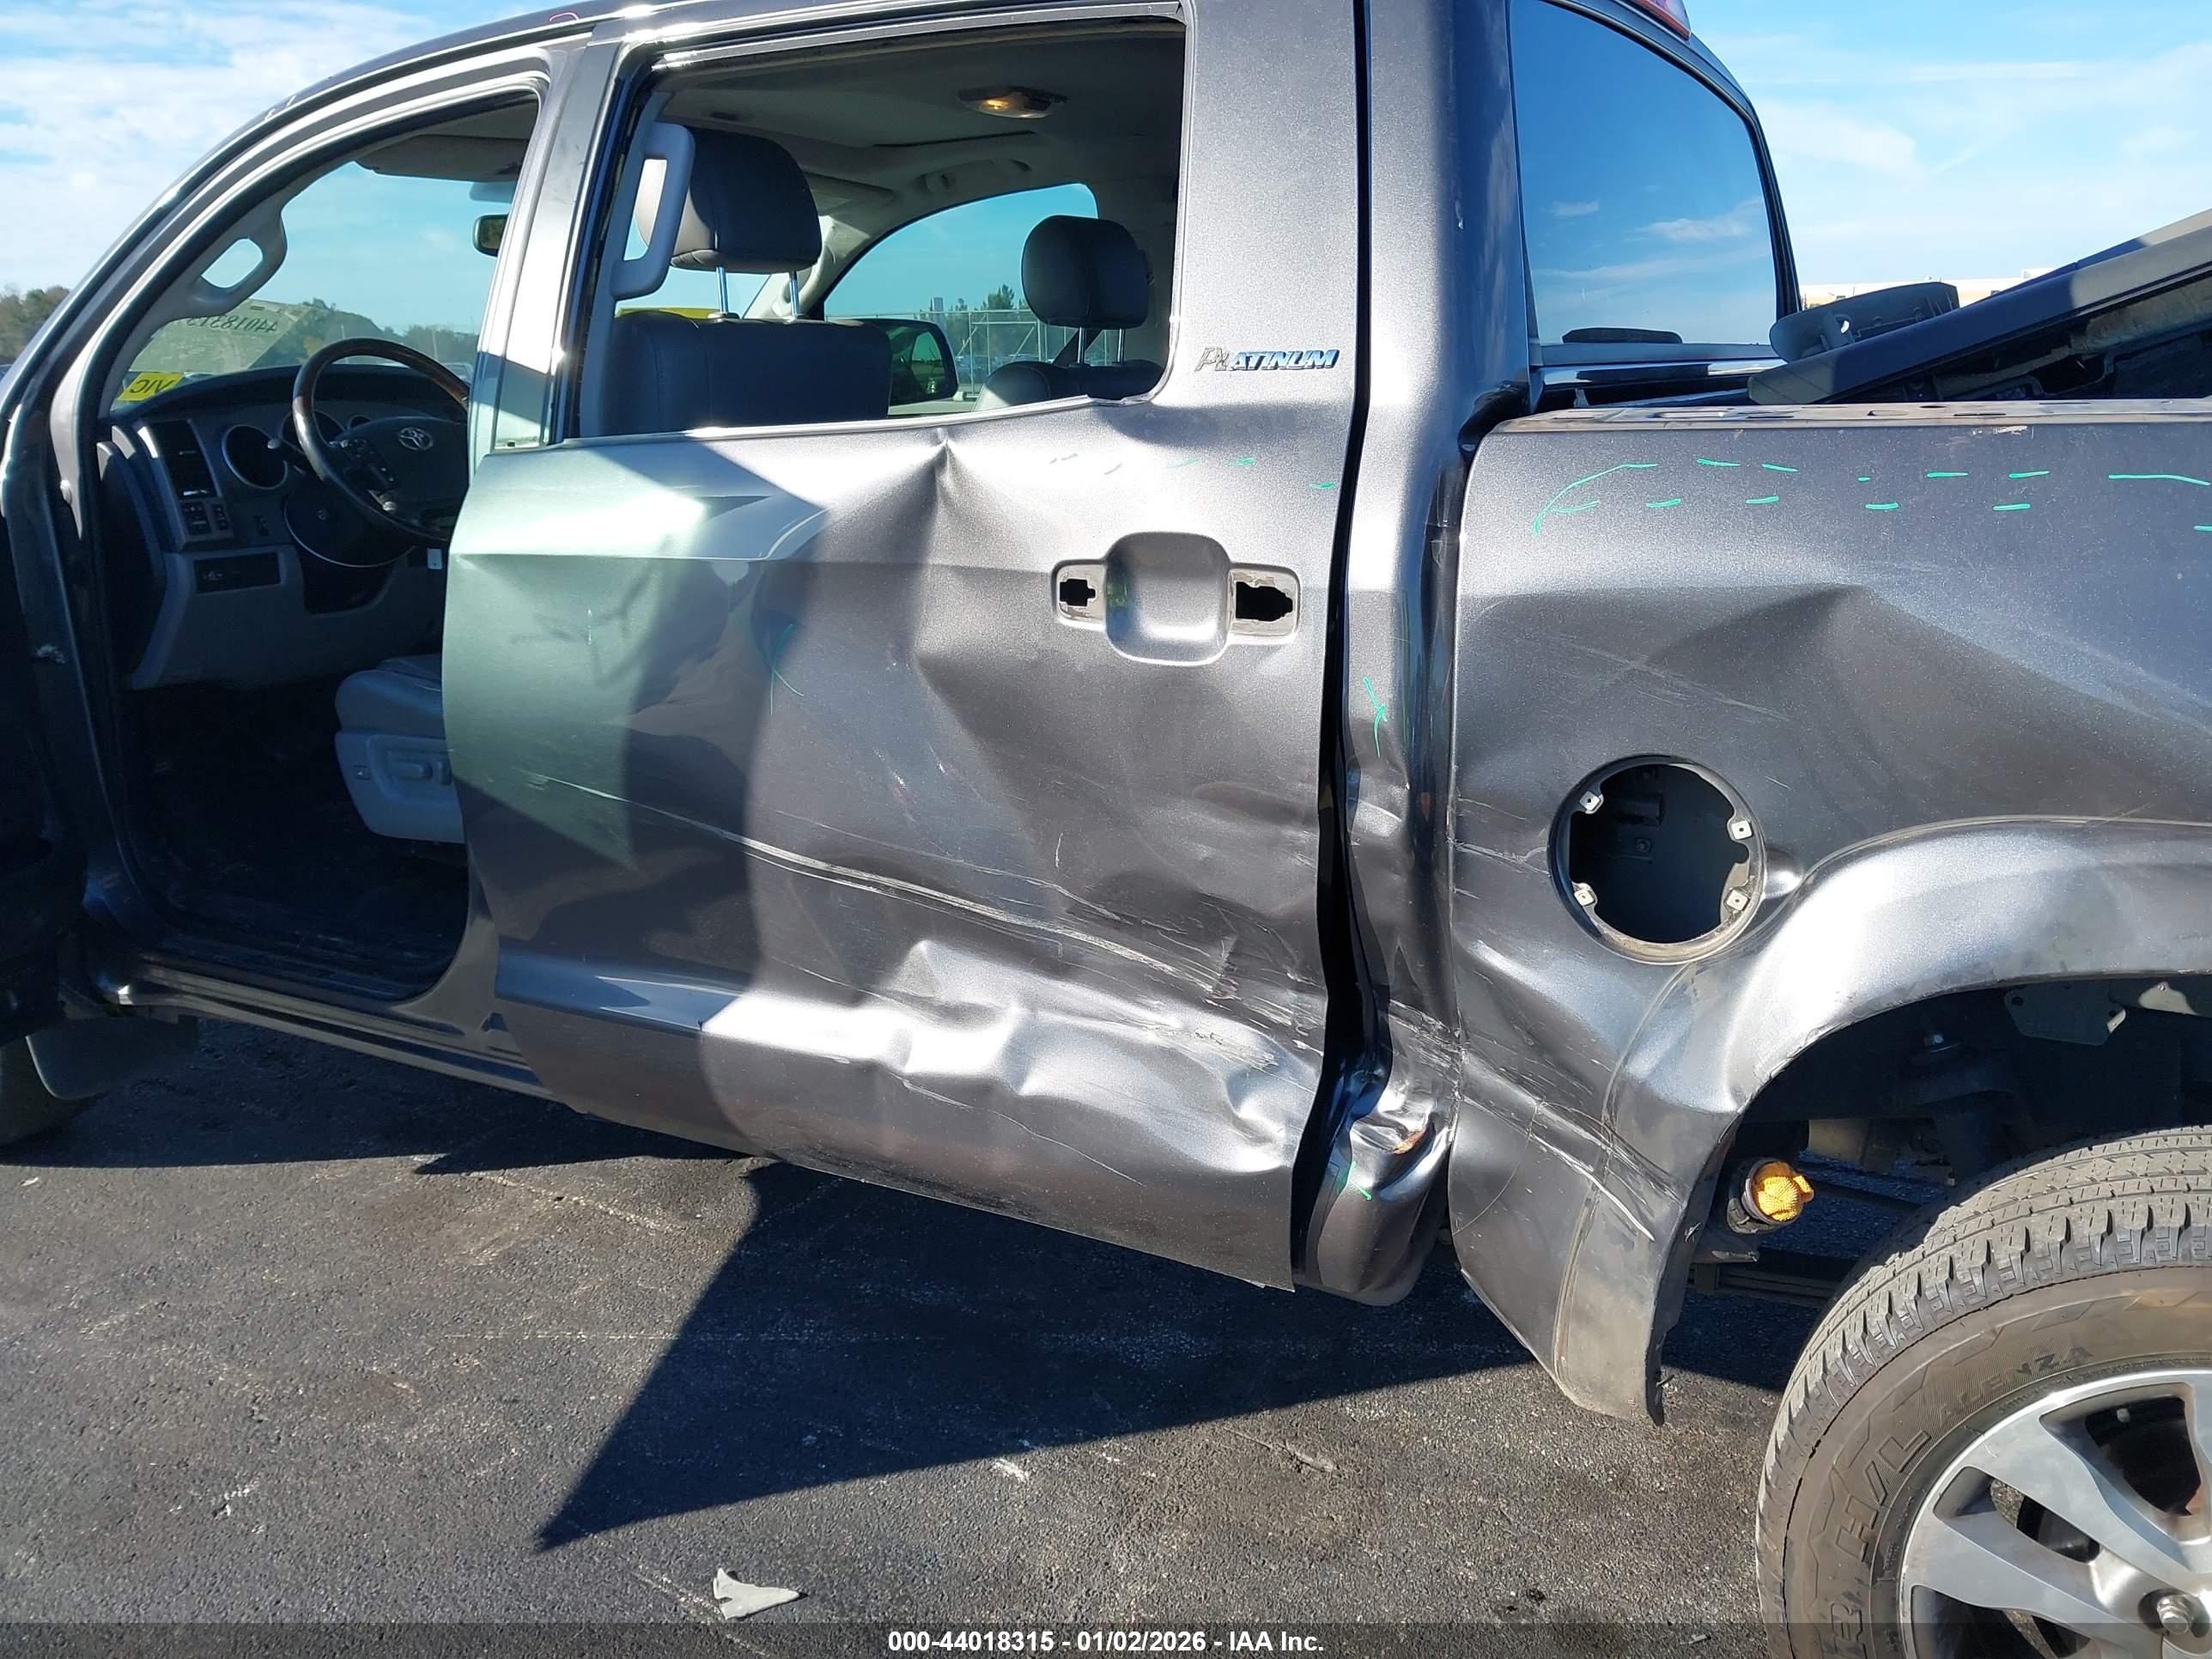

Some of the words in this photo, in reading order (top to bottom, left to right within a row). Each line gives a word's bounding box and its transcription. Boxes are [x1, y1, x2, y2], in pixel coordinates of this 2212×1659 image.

[1194, 347, 1340, 372] PLATINUM
[1835, 1430, 1932, 1563] H/L
[1939, 1345, 2094, 1422] ALENZA
